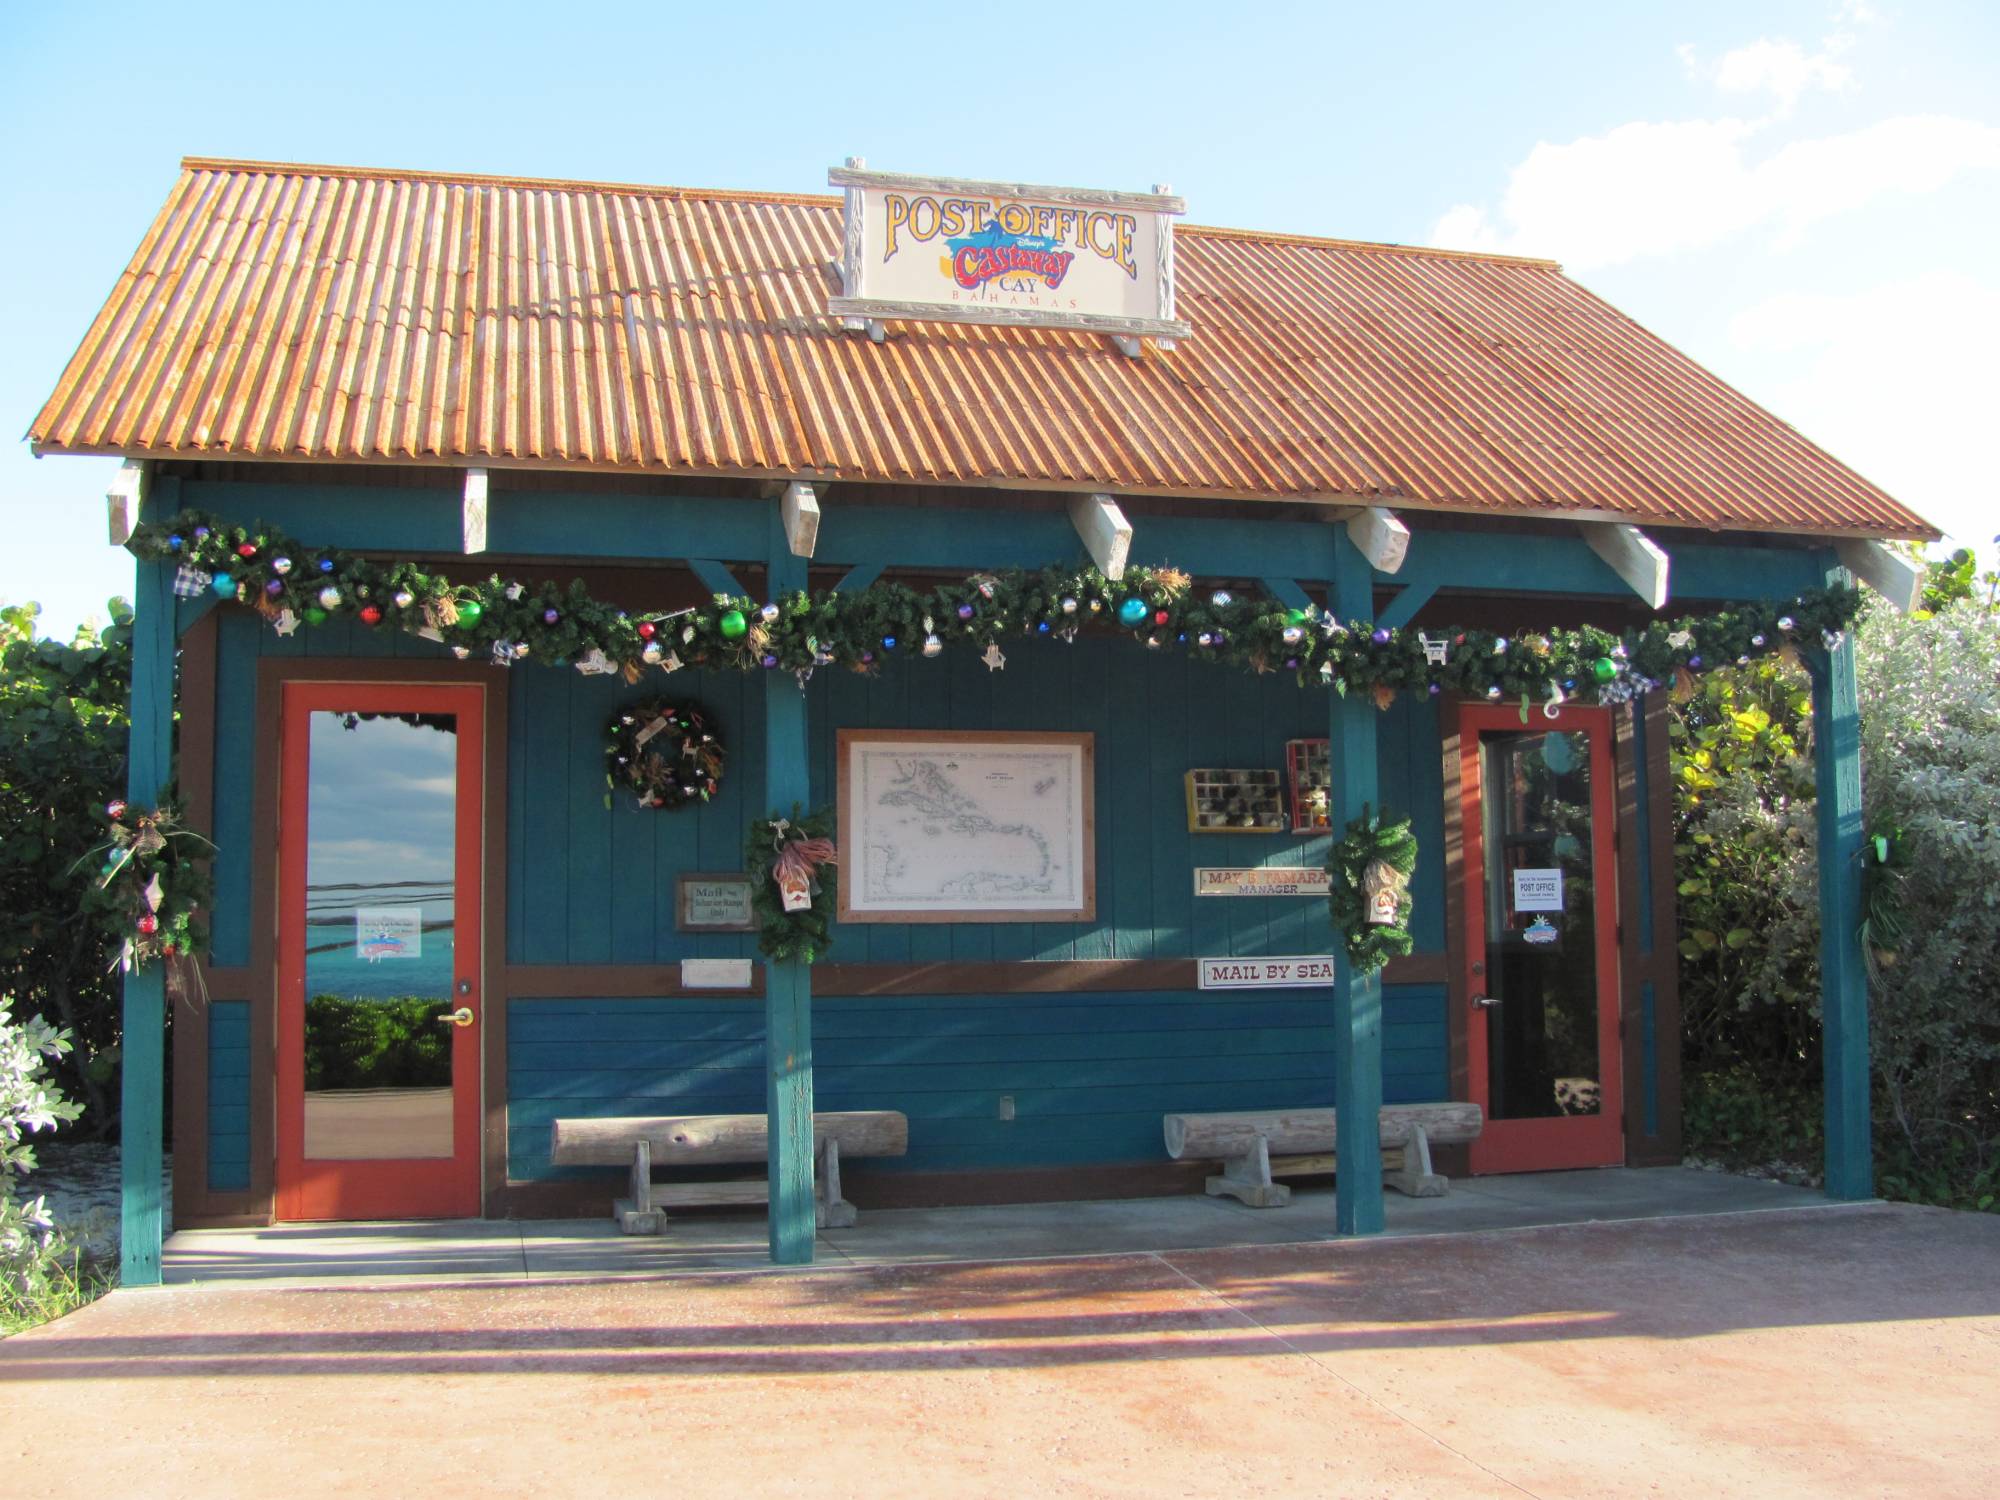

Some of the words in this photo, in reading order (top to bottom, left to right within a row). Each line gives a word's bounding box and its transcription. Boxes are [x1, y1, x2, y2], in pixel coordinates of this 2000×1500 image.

[884, 194, 990, 264] POST
[999, 204, 1137, 280] OFFICE
[952, 243, 1076, 290] Castaway
[999, 277, 1038, 293] CAY
[952, 290, 1078, 309] BAHAMAS
[1209, 872, 1242, 884] MAY
[1264, 872, 1328, 884] TAMARA
[1239, 885, 1298, 894] MANAGER
[1520, 883, 1534, 891] POST
[1536, 882, 1556, 891] OFFICE
[1212, 966, 1260, 980] MAIL
[1266, 965, 1291, 979] BY
[1296, 964, 1333, 978] SEA
